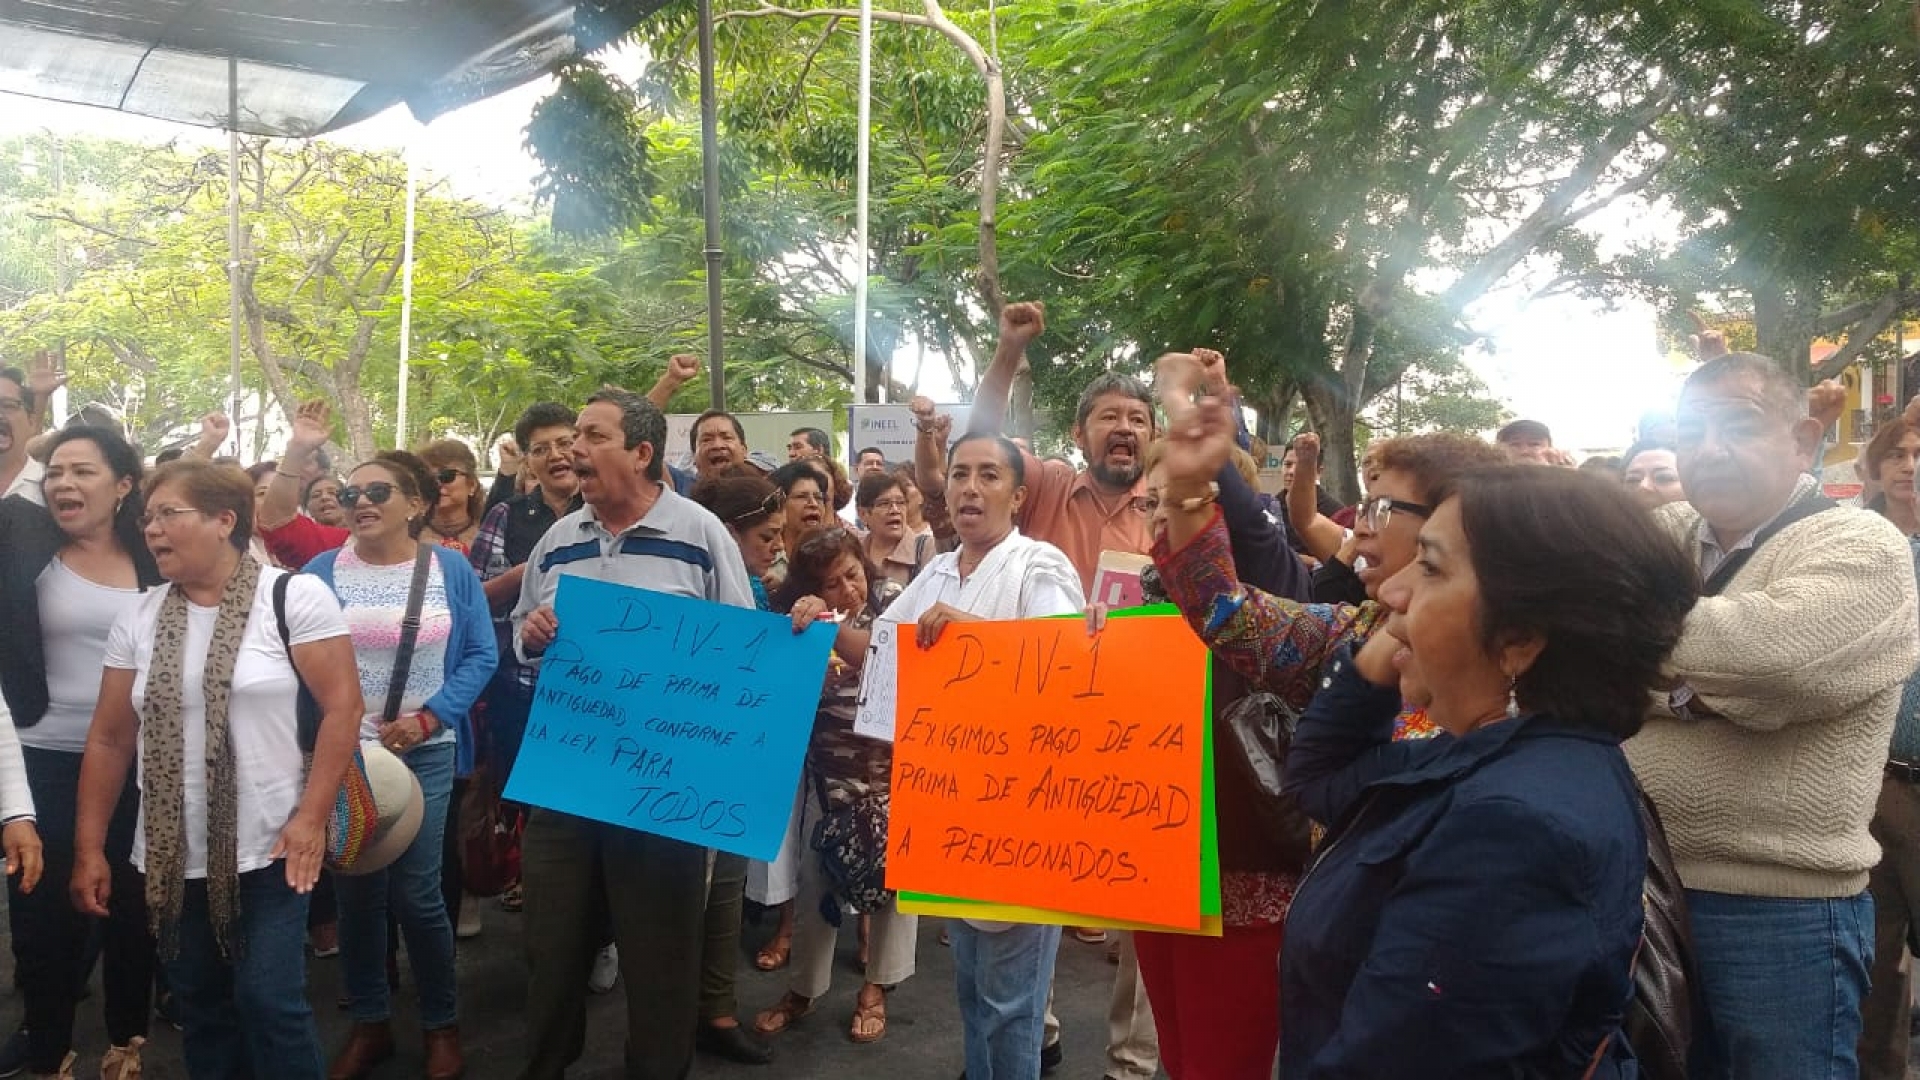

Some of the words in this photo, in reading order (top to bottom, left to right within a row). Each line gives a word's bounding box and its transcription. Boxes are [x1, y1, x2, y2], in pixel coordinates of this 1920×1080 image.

[599, 596, 769, 673] D-IV-1
[944, 630, 1105, 698] D-IV-1
[545, 638, 602, 685] PAGO
[615, 668, 652, 690] DE
[663, 674, 721, 698] PRIMA
[735, 693, 772, 709] DE
[527, 722, 548, 741] LA
[610, 737, 674, 780] PARA
[644, 717, 737, 746] CONFORME
[753, 731, 766, 747] A
[900, 707, 1009, 756] EXIGIMOS
[1028, 723, 1081, 757] PAGO
[1095, 719, 1141, 752] DE
[1149, 723, 1184, 751] LA
[627, 785, 746, 838] TODOS
[896, 762, 959, 801] PRIMA
[977, 773, 1019, 802] DE
[1027, 764, 1190, 831] ANTIGÜEDAD
[896, 827, 912, 856] A
[941, 826, 1149, 886] PENSIONADOS.
